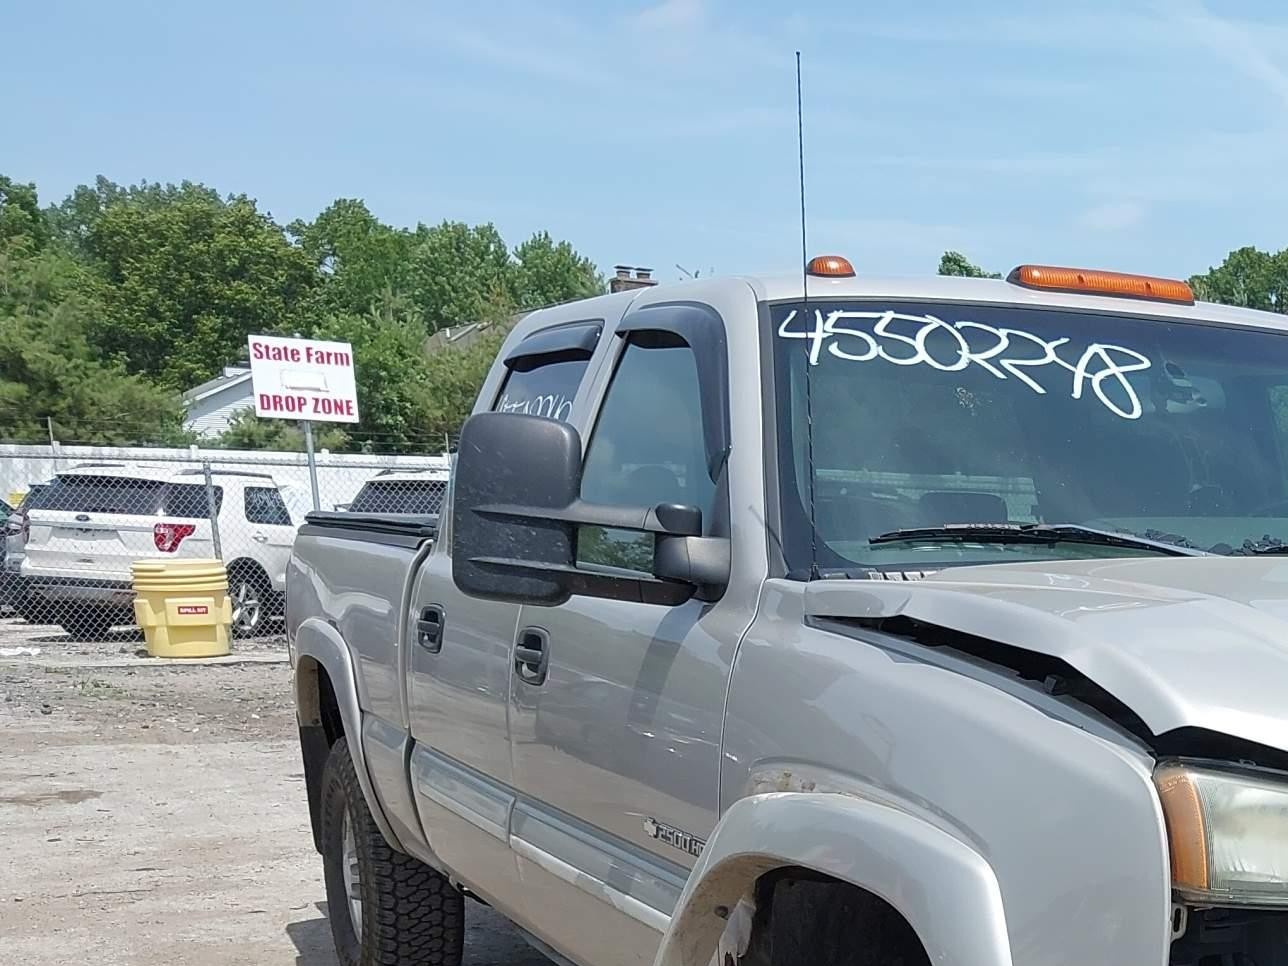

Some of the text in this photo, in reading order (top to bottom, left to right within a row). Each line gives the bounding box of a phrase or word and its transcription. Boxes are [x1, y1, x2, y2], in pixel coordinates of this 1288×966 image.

[252, 342, 351, 367] State Farm
[259, 393, 355, 416] DROP ZONE
